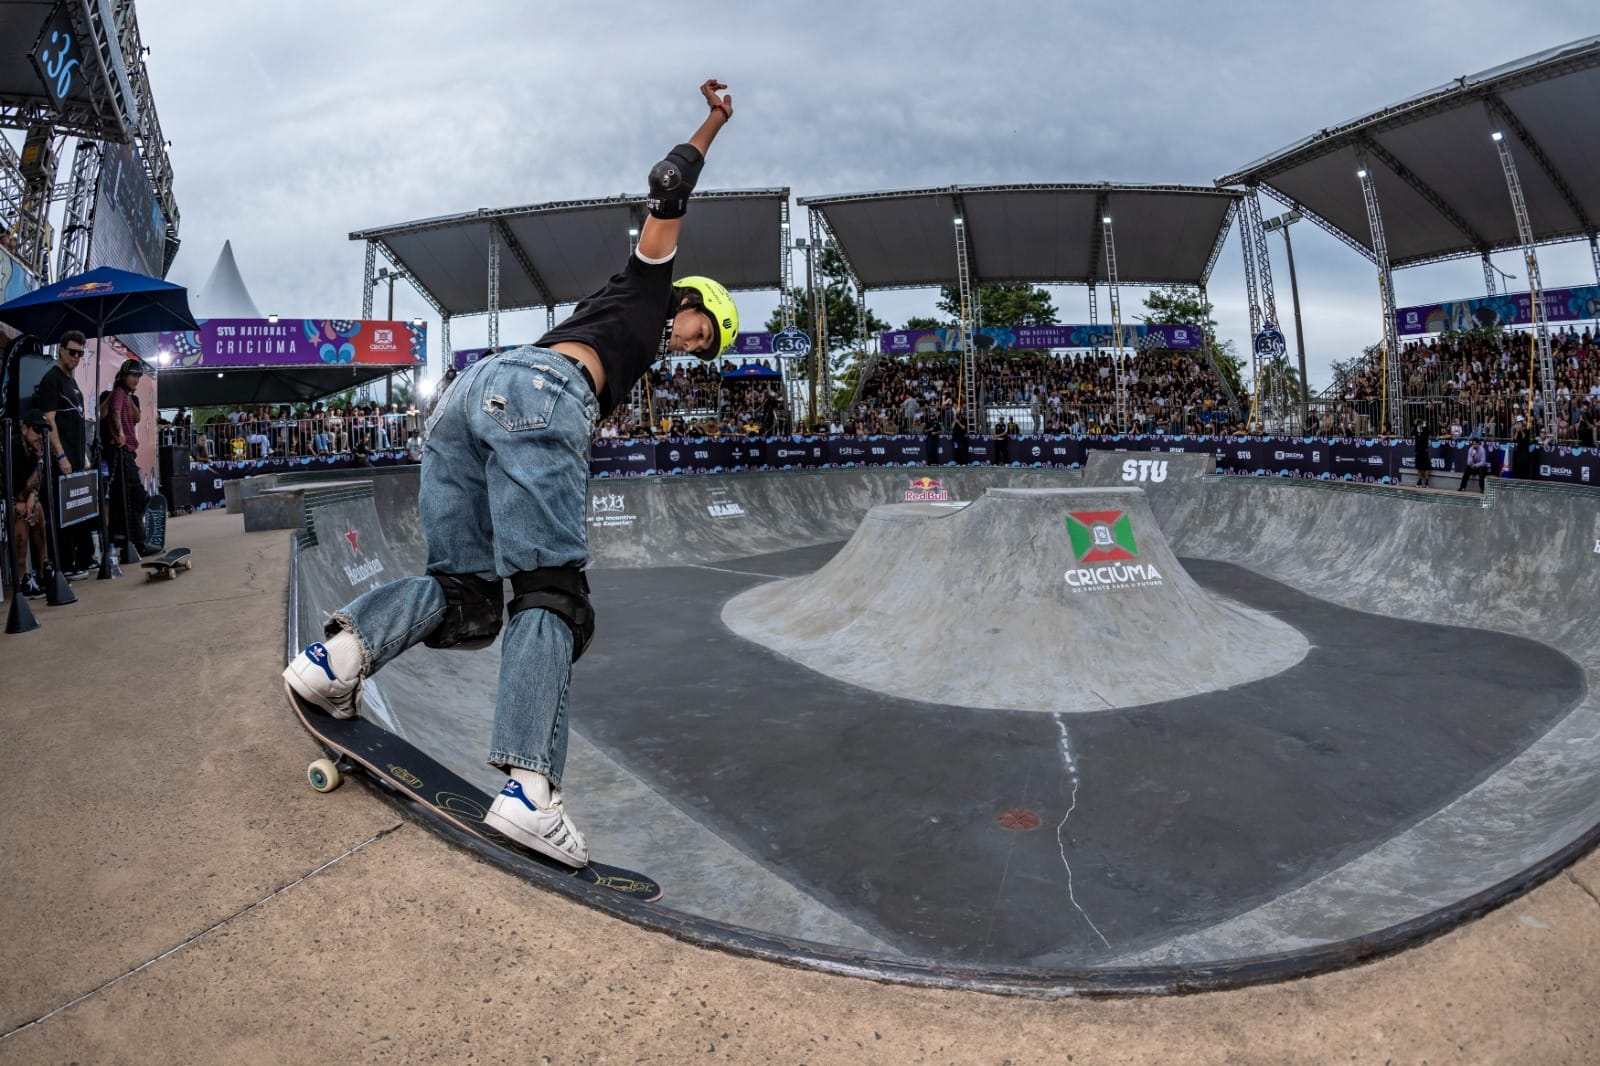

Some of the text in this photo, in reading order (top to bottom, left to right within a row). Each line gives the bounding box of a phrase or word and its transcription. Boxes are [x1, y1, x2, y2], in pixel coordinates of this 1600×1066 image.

[217, 326, 236, 336] STU
[240, 326, 287, 336] NATIONAL
[216, 337, 296, 354] CRICIÚMA
[694, 450, 708, 459] STU
[872, 447, 885, 455] STU
[1053, 447, 1066, 455] STU
[1237, 450, 1251, 459] STU
[1431, 458, 1445, 468] STU
[1122, 459, 1168, 483] STU
[905, 490, 948, 501] Red Bull
[343, 557, 385, 587] Heineken
[1064, 562, 1162, 587] CRICIÚMA
